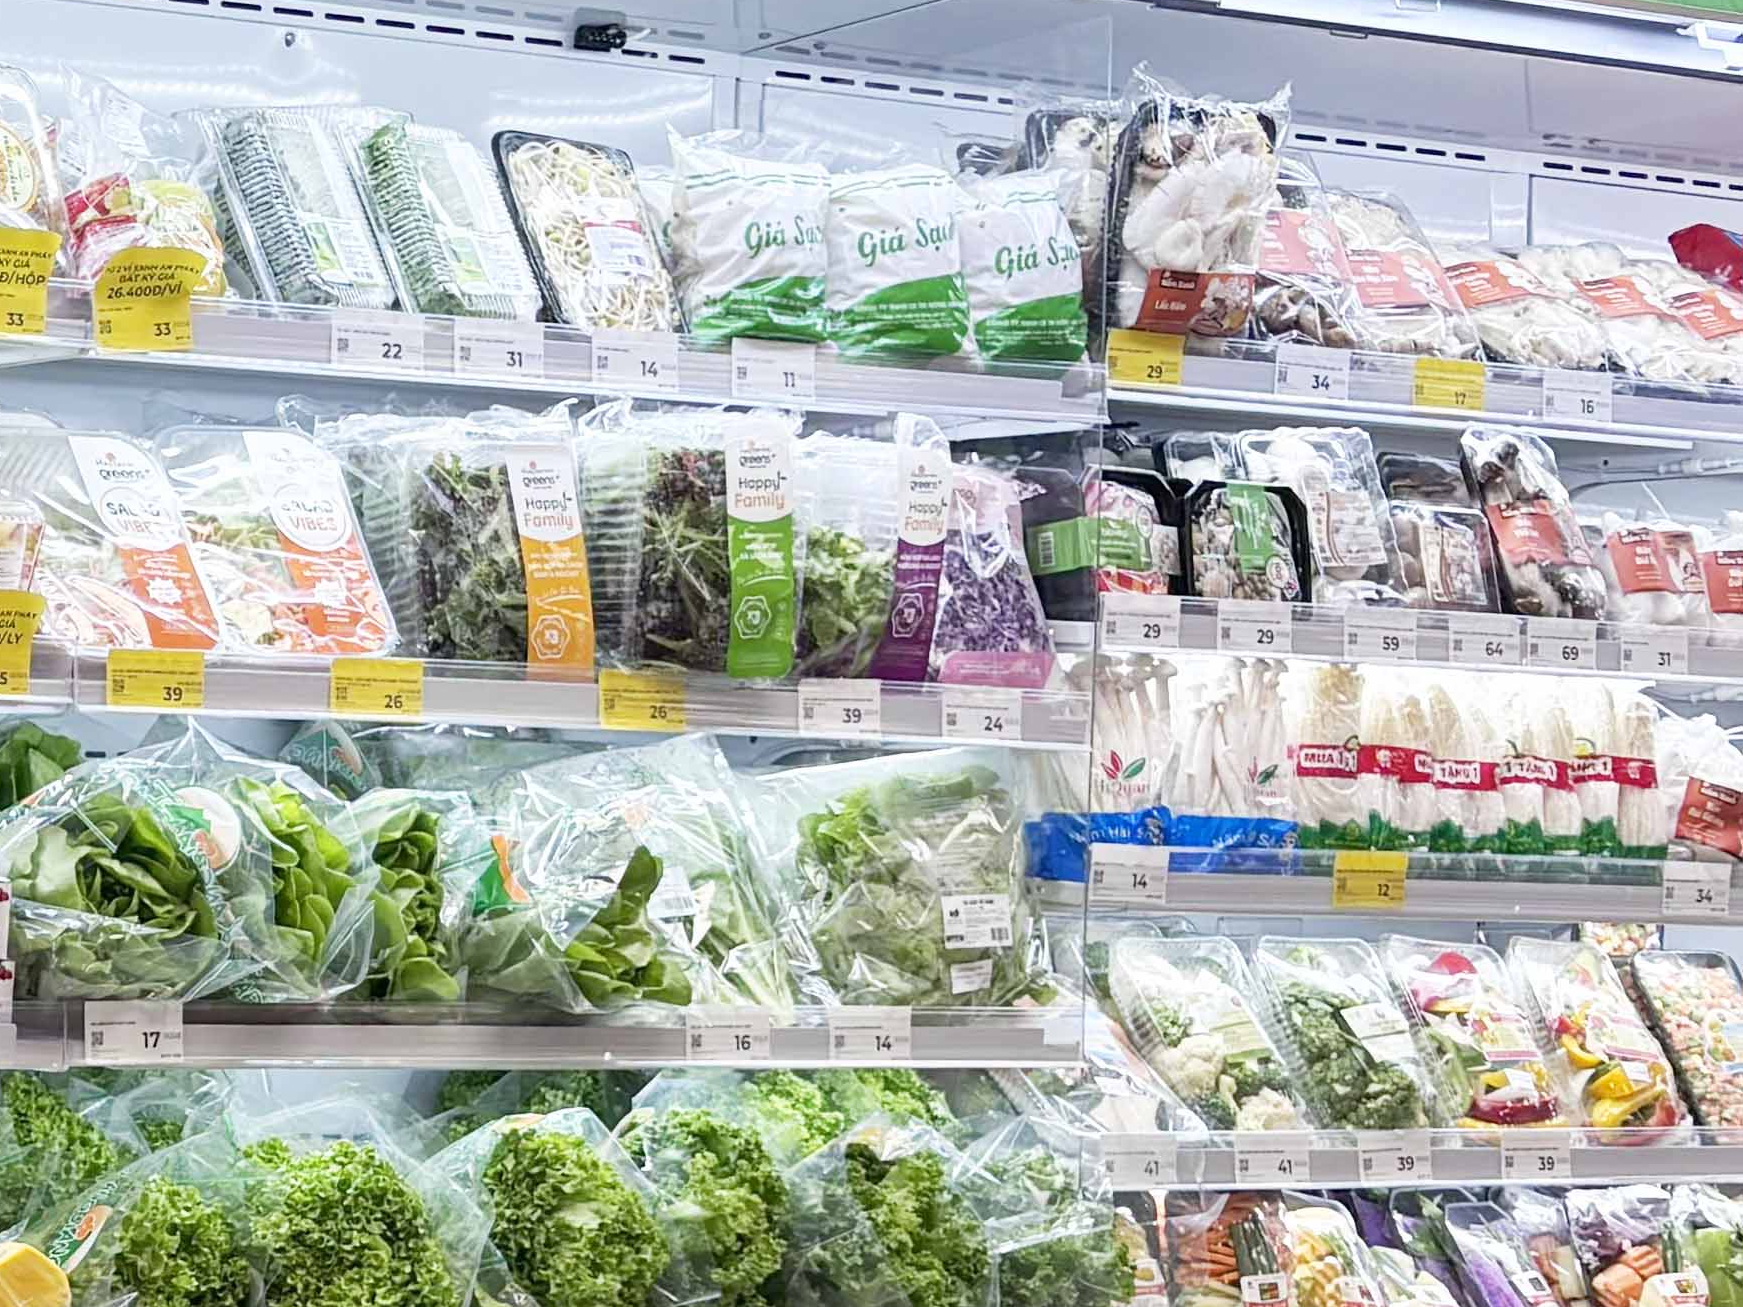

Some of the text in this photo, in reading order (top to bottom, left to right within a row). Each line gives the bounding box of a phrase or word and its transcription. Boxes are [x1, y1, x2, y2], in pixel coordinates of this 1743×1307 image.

[744, 219, 785, 259] Giá
[858, 227, 905, 267] Giá
[995, 242, 1039, 278] Giá
[507, 351, 522, 367] 31
[1147, 365, 1163, 379] 29
[1581, 399, 1594, 414] 16
[735, 493, 785, 510] Family
[1257, 629, 1274, 644] 29
[1485, 642, 1503, 656] 64
[385, 694, 403, 709] 26
[843, 708, 862, 723] 39
[1132, 873, 1147, 889] 14
[876, 1035, 892, 1051] 14
[1278, 1159, 1292, 1174] 41
[1538, 1156, 1555, 1171] 39
